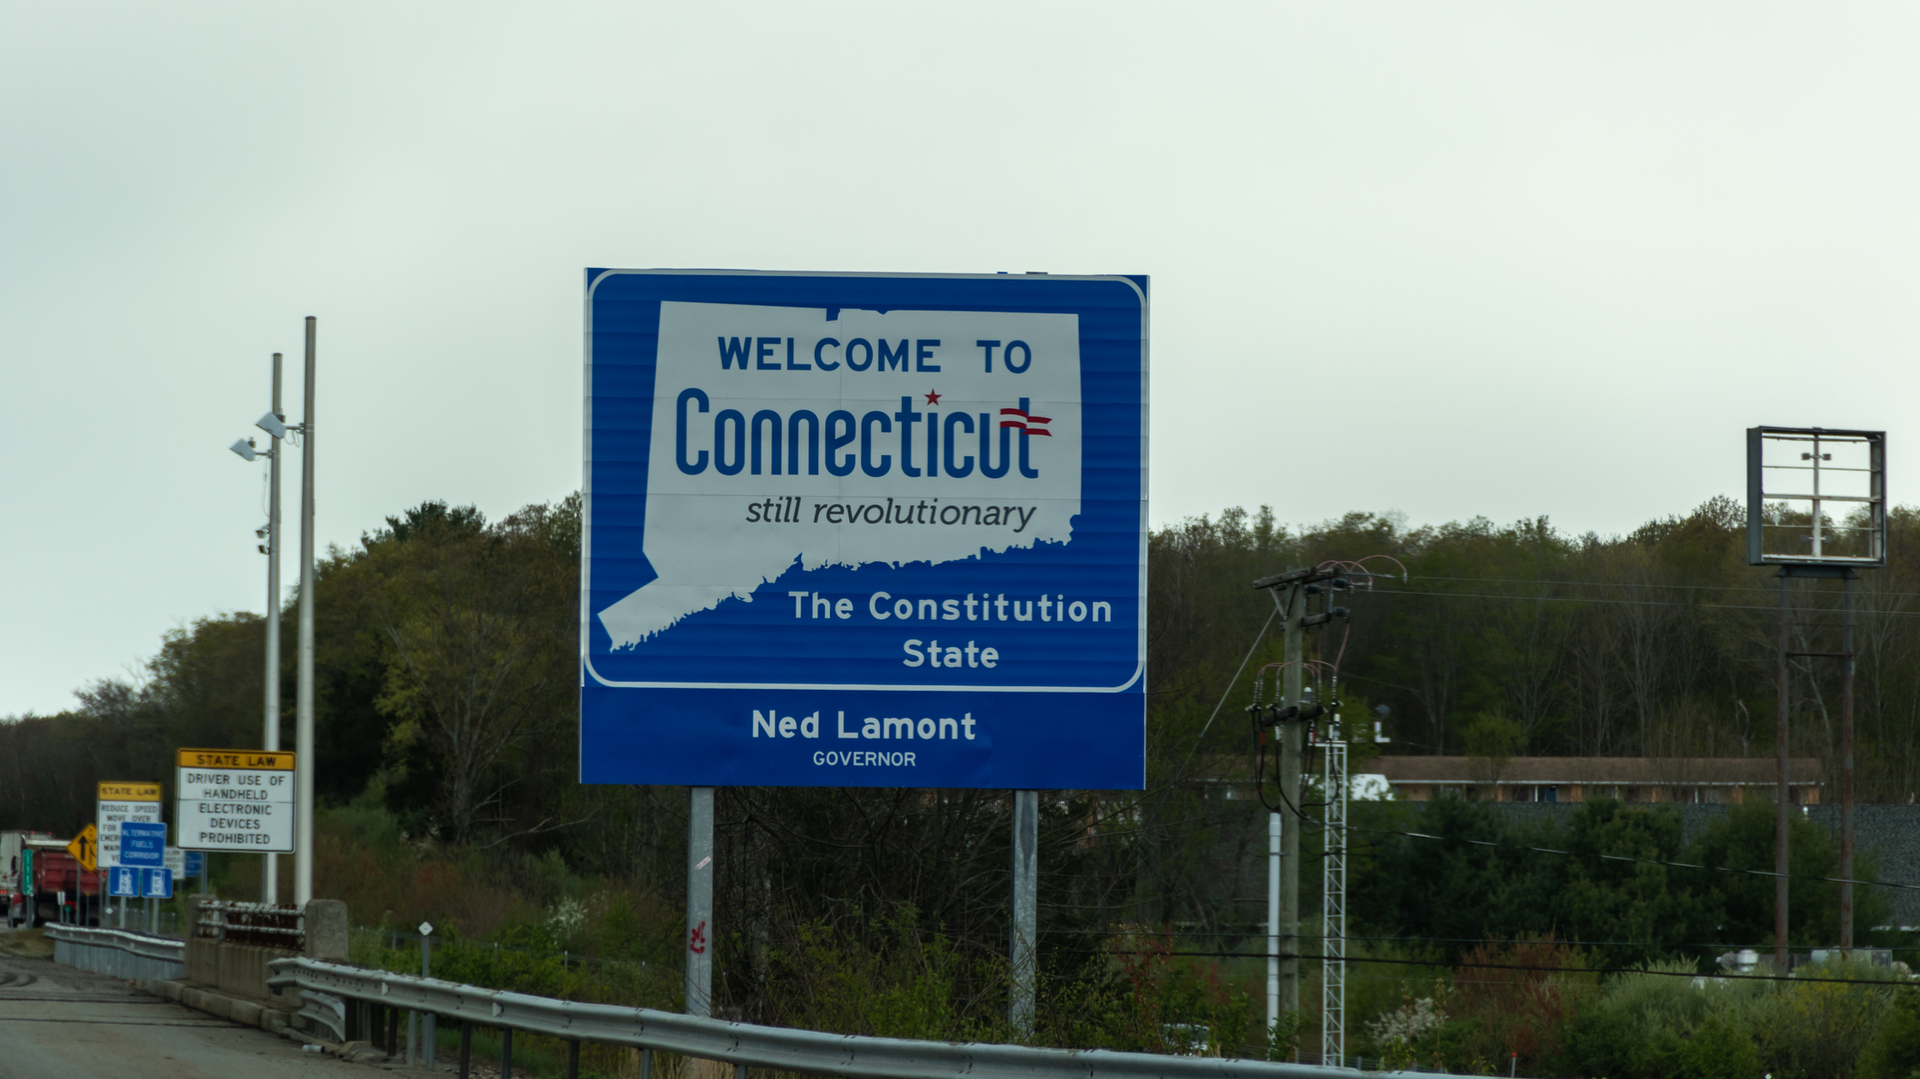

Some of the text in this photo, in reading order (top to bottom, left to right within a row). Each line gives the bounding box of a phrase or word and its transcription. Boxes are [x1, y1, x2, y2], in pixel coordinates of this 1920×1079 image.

[717, 336, 1032, 374] WELCOME TO
[675, 387, 1040, 479] Connecticut
[745, 496, 1038, 533] still revolutionary
[788, 590, 1112, 622] The Constitution
[902, 639, 1000, 669] State
[751, 709, 977, 740] Ned Lamont
[197, 754, 277, 767] STATE LAW
[812, 751, 917, 767] GOVERNOR
[187, 773, 286, 787] DRIVER USE OF
[101, 787, 158, 797] STATE LAW
[203, 788, 268, 801] HANDHELD
[101, 804, 158, 814] REDUCE SPEED
[199, 802, 273, 816] ELECTRONIC
[107, 814, 151, 823] MOVE OVER
[210, 817, 261, 830] DEVICES
[103, 824, 117, 832] FOR
[122, 829, 166, 839] ALTERNATIVE
[200, 831, 271, 845] PROHIBITED
[131, 840, 154, 850] FUELS
[124, 850, 160, 860] CORRIDOR
